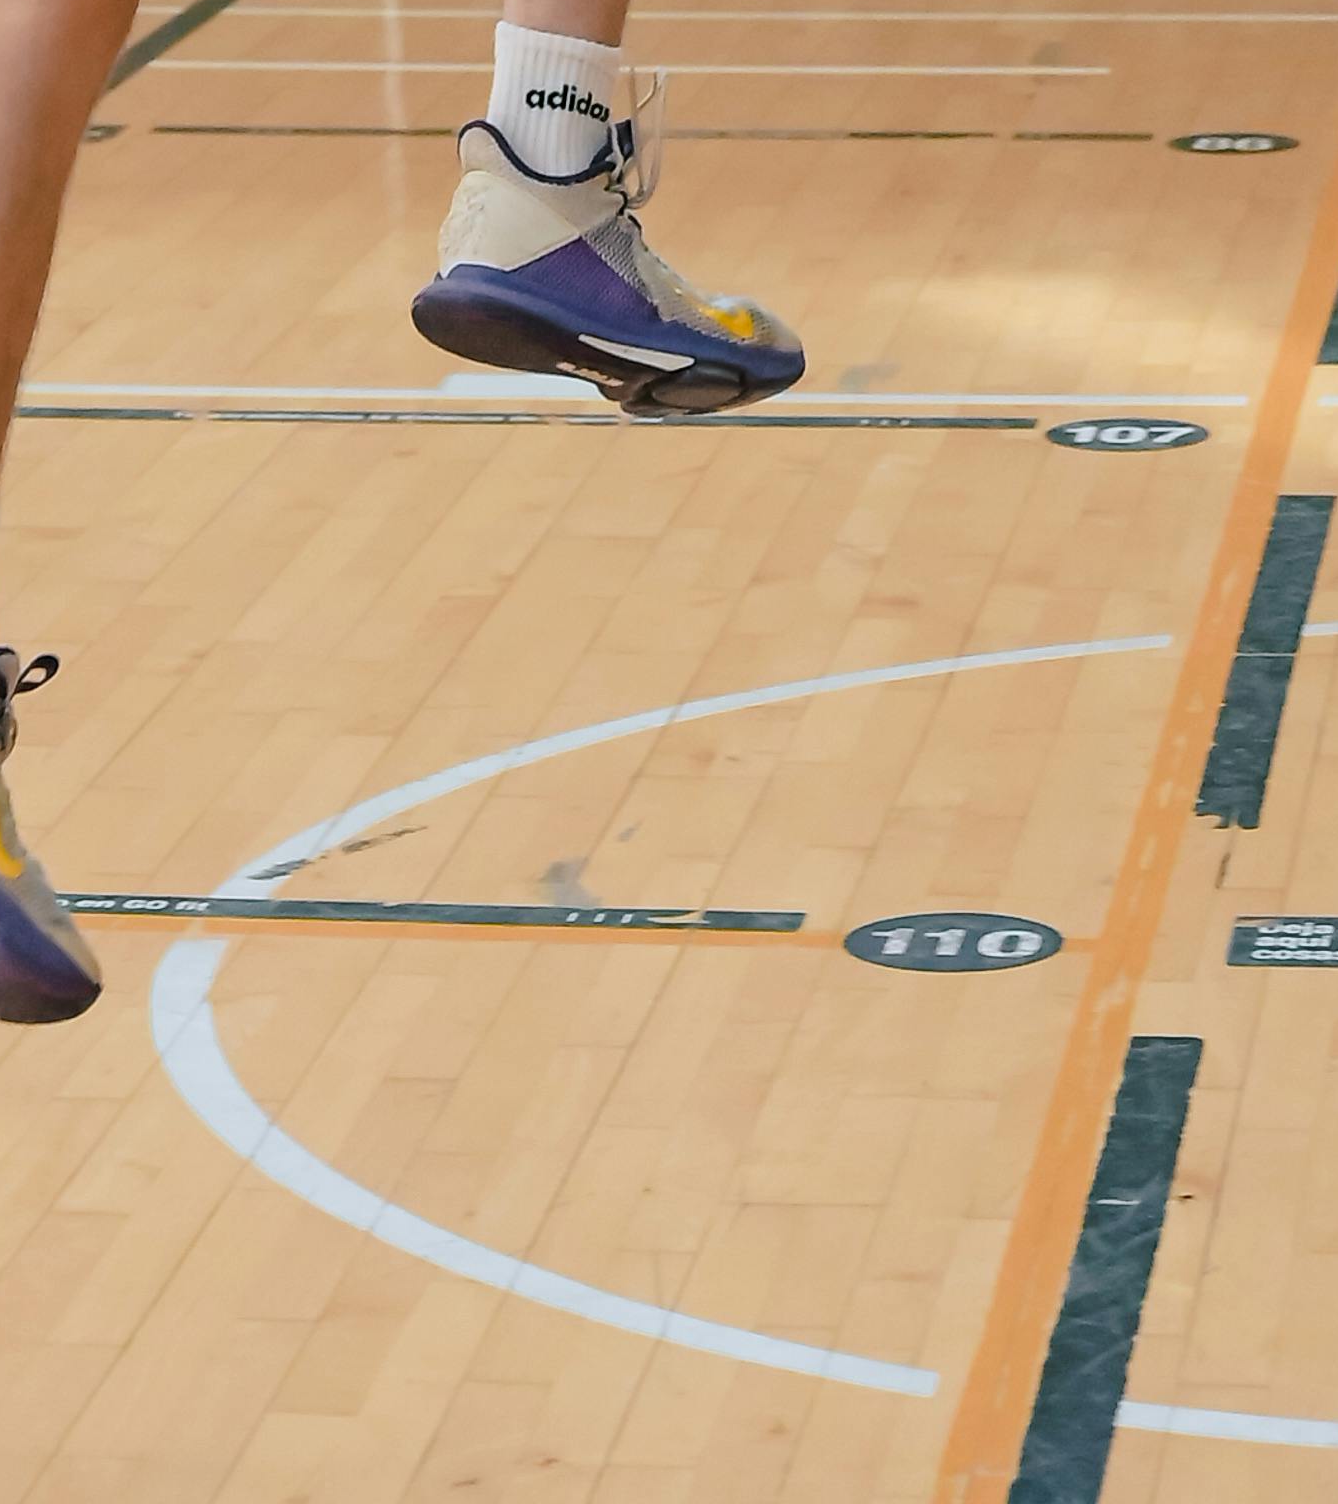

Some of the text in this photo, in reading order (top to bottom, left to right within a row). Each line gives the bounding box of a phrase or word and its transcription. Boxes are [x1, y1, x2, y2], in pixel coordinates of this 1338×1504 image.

[1065, 425, 1197, 445] 107
[122, 899, 170, 910] GO
[174, 900, 209, 911] fit
[871, 927, 1043, 958] 110
